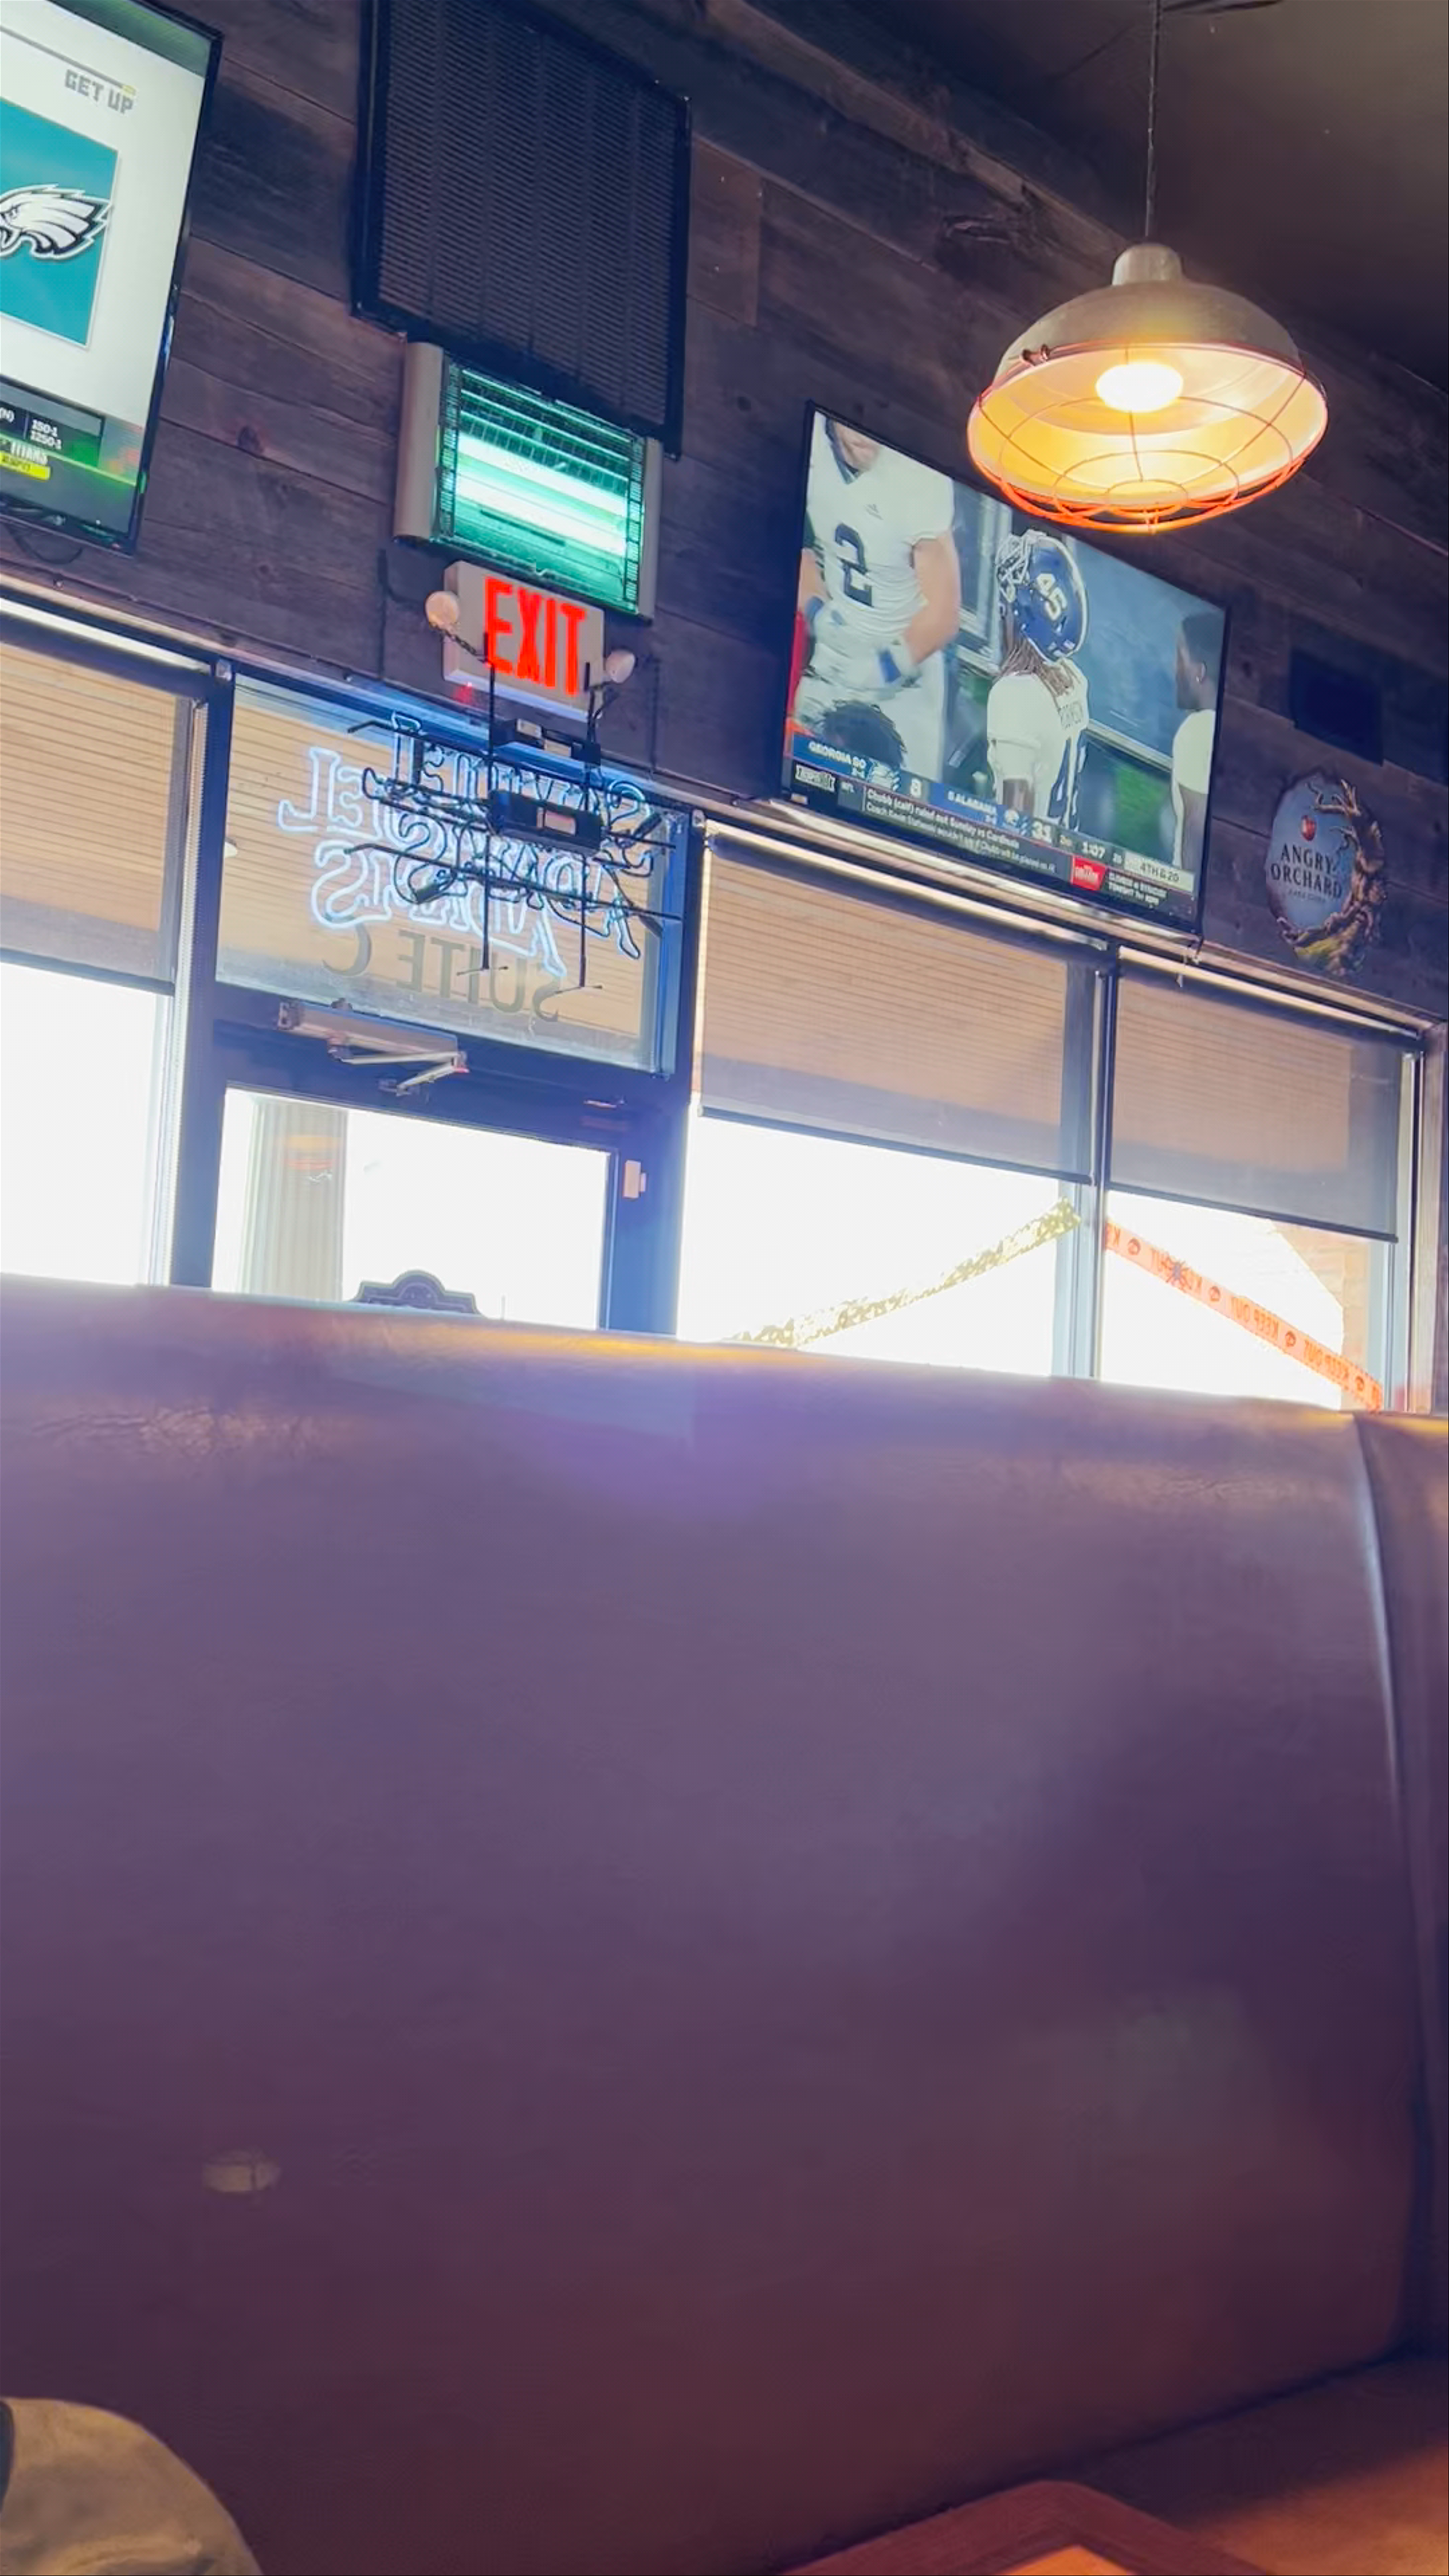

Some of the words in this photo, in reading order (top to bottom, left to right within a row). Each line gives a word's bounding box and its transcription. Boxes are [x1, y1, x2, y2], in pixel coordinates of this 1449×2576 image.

[65, 69, 103, 103] GET
[108, 93, 134, 114] UP
[834, 521, 875, 608] 2
[484, 576, 587, 696] EXIT
[808, 741, 852, 764] GEORGIA
[1281, 843, 1332, 875] ANGRY
[1271, 863, 1342, 898] ORCHARD
